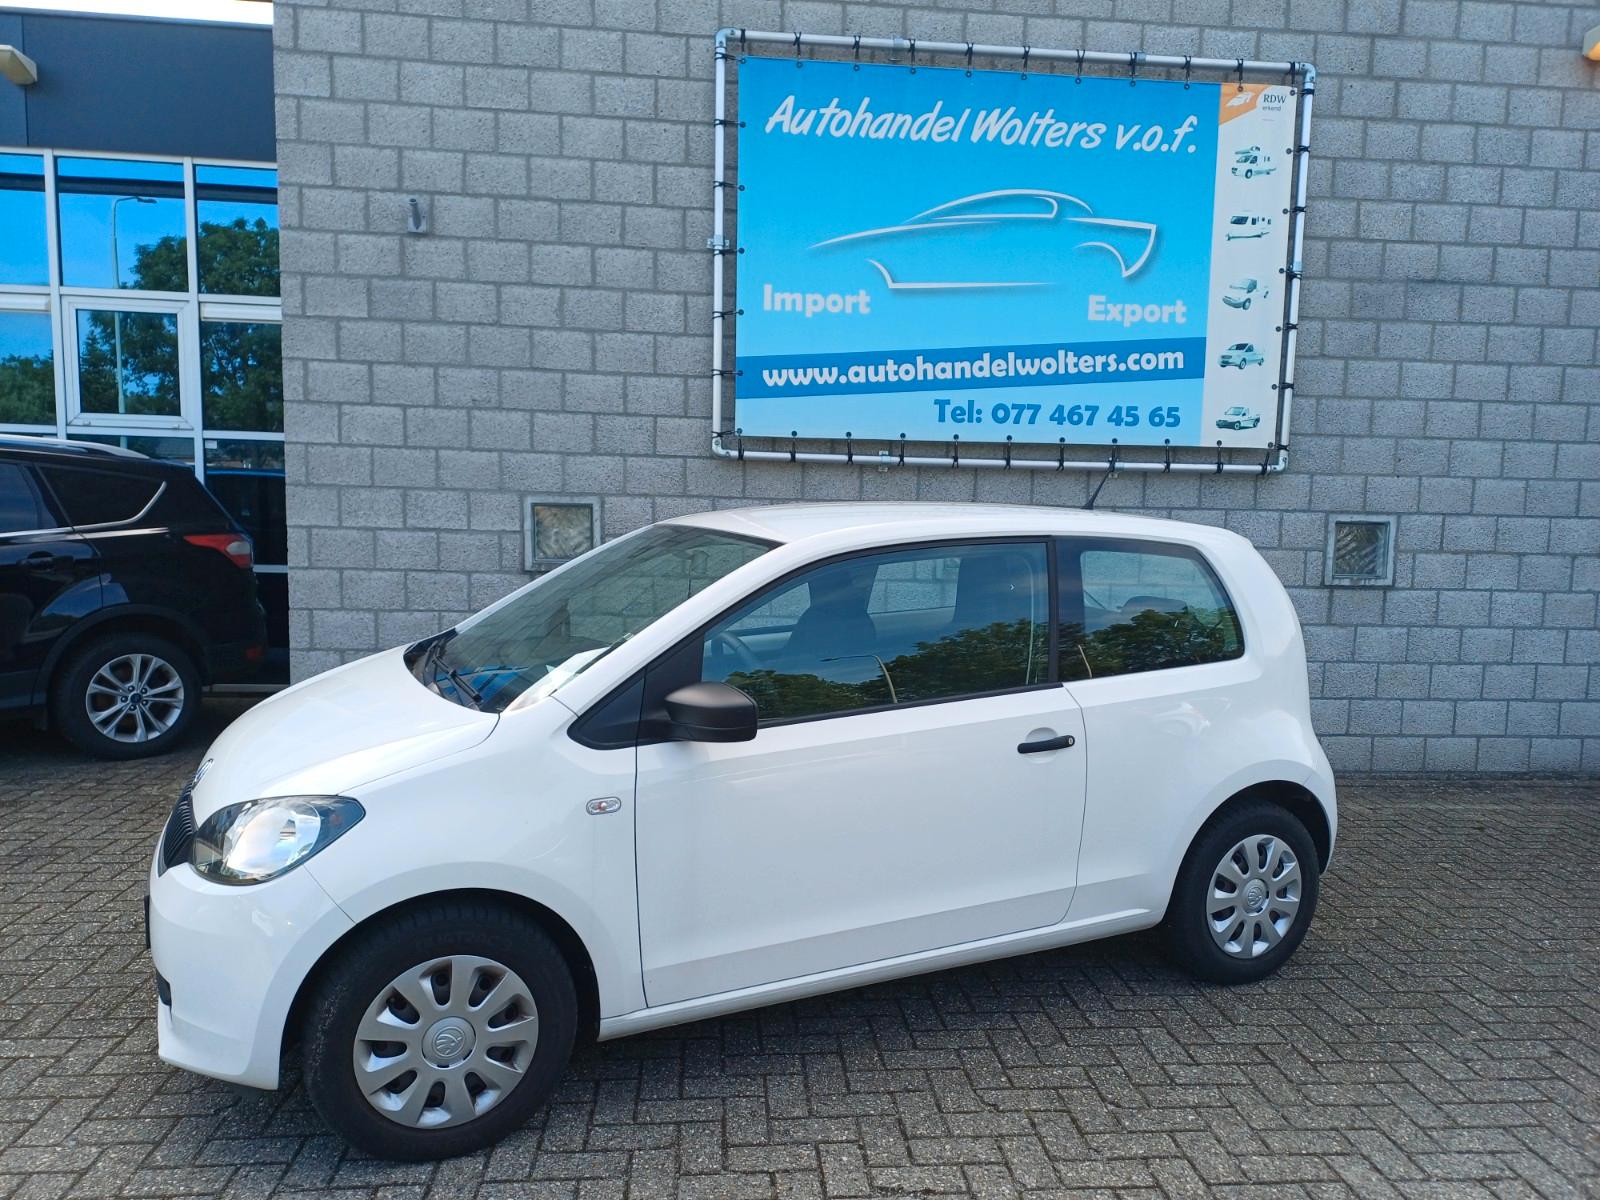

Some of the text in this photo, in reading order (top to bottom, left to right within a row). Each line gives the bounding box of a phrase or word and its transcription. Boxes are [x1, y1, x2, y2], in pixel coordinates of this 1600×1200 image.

[1263, 94, 1287, 104] RDW
[764, 95, 1198, 153] Autohandel Wolters v.o.f.
[763, 284, 871, 317] Import
[1087, 294, 1187, 327] Export
[762, 349, 1184, 387] www.autohandelwolters.com
[933, 399, 1181, 428] Tel: 077 467 45 65
